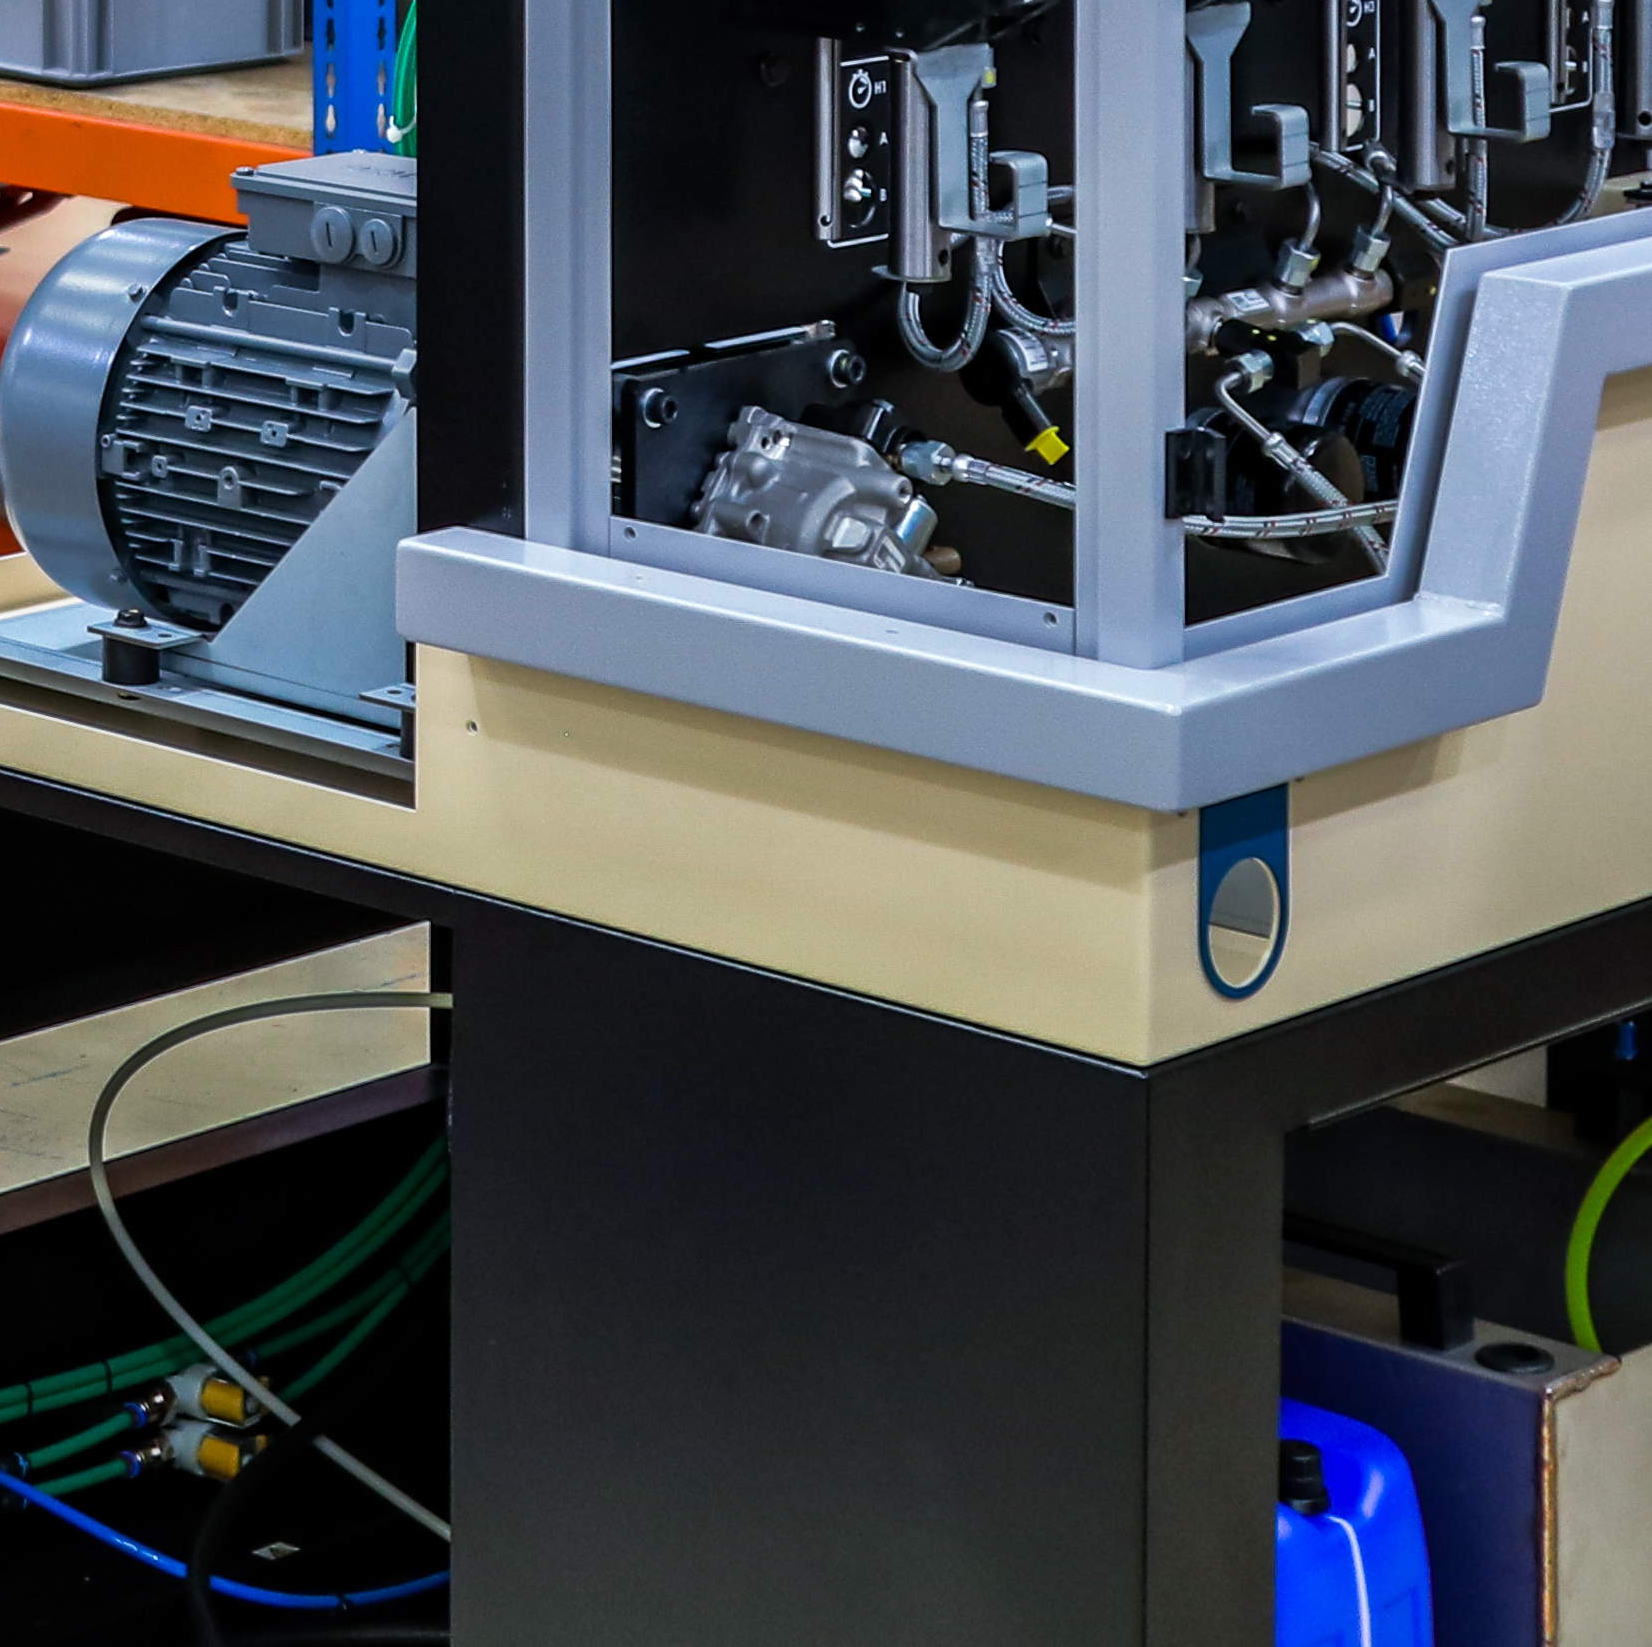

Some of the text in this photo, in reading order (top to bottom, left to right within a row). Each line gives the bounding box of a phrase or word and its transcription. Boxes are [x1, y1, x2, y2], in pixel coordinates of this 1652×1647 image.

[1368, 47, 1376, 61] A
[874, 79, 887, 95] H1
[879, 131, 889, 146] A
[879, 187, 888, 202] B
